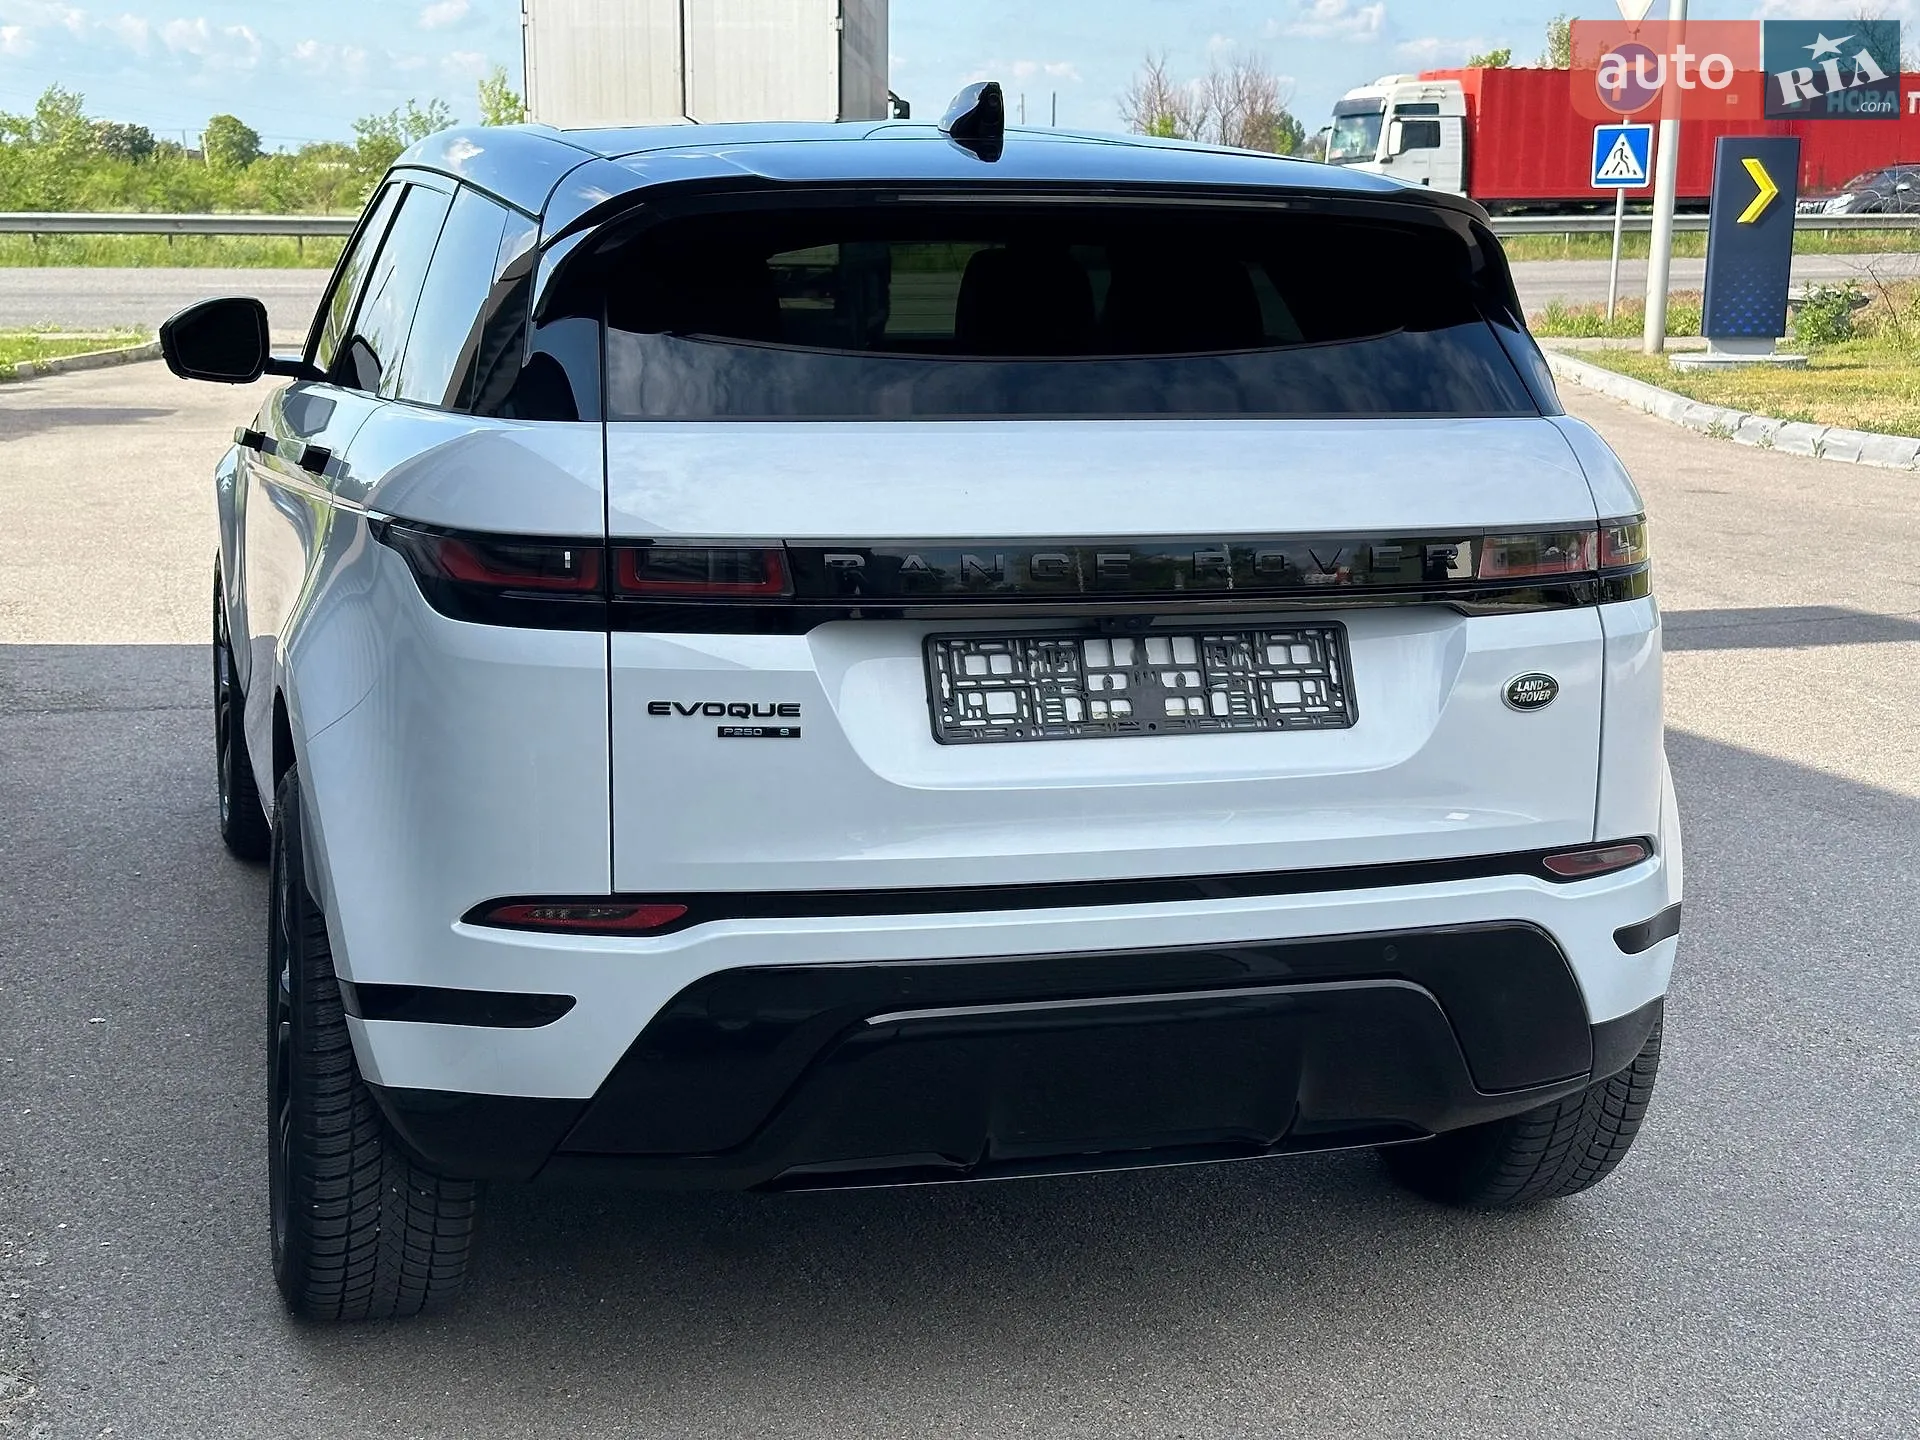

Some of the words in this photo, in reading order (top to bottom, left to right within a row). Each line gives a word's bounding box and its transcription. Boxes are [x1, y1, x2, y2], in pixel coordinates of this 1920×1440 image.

[823, 552, 1132, 583] RANGE
[1192, 543, 1459, 580] ROVER
[1516, 680, 1544, 692] LAND
[1518, 690, 1551, 703] ROVER
[647, 701, 801, 720] EVOQUE
[723, 728, 763, 736] P250
[779, 728, 790, 736] S
